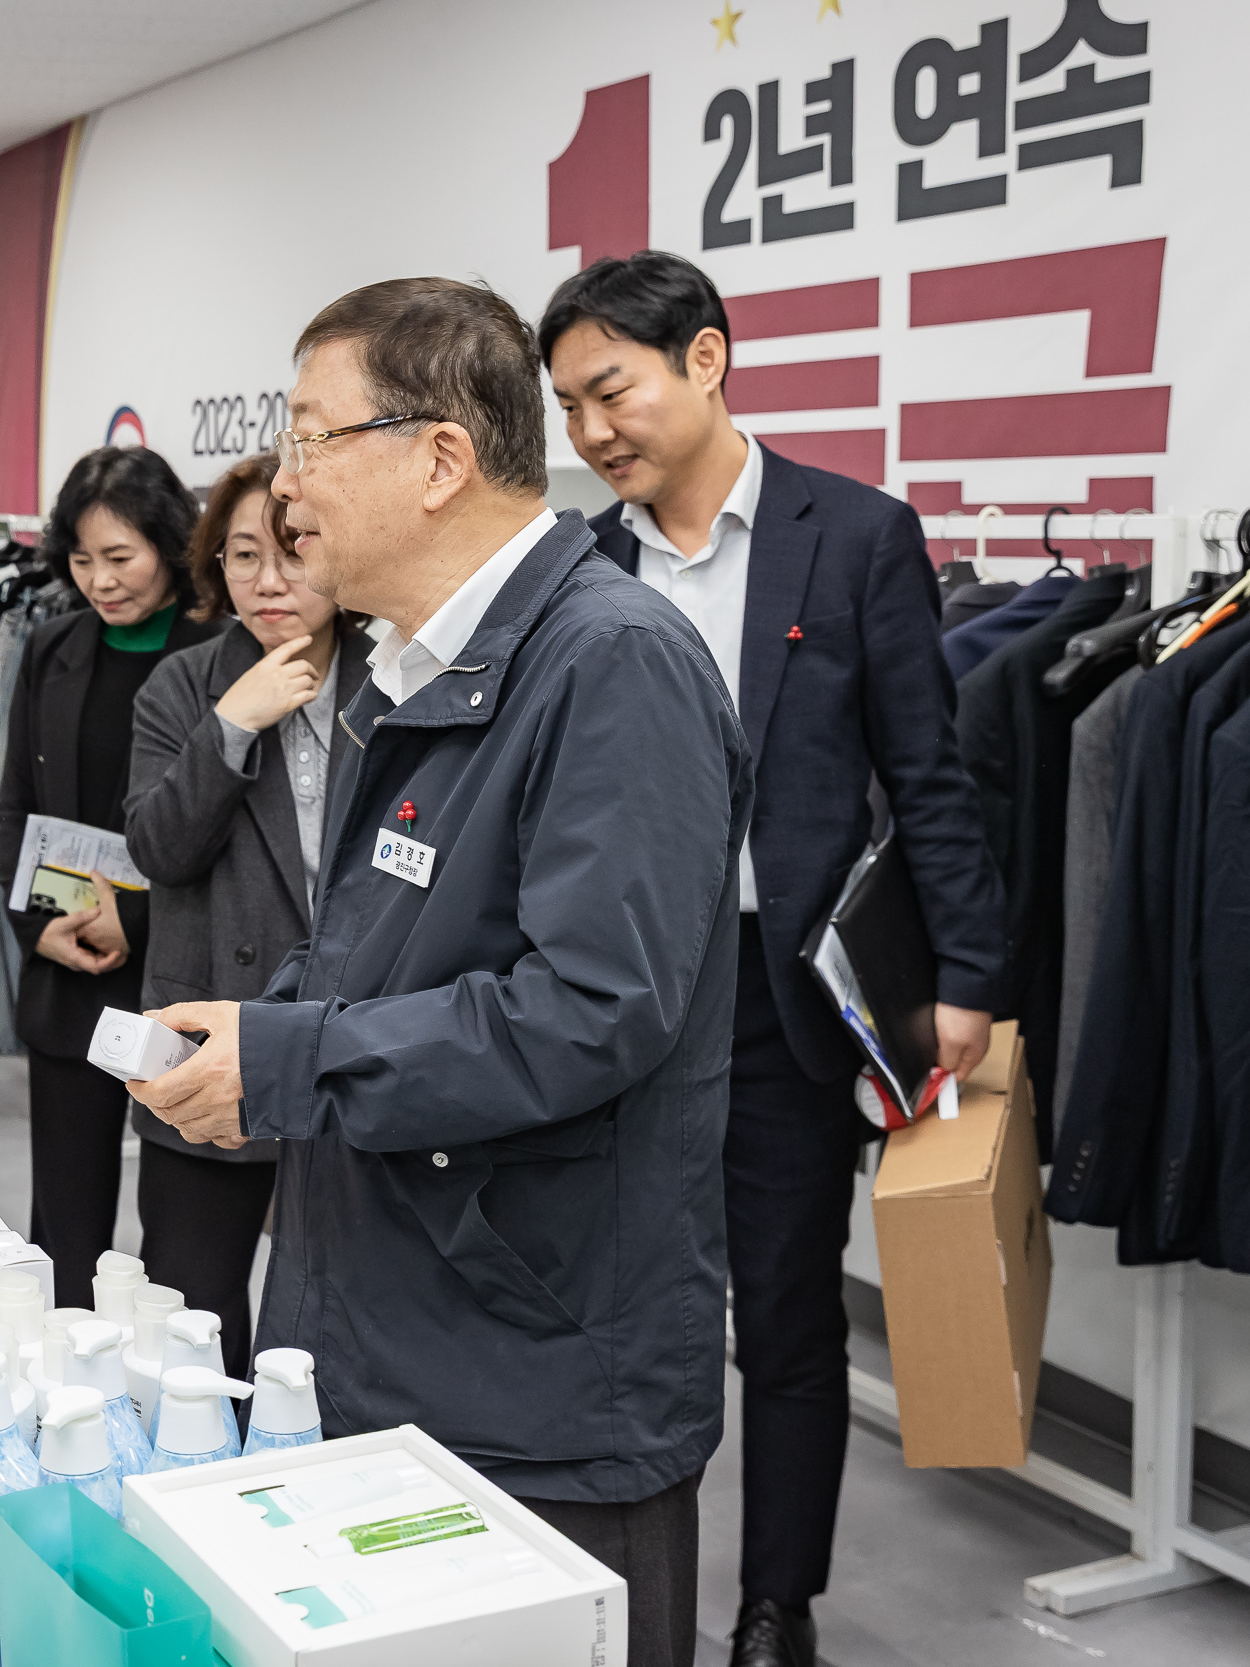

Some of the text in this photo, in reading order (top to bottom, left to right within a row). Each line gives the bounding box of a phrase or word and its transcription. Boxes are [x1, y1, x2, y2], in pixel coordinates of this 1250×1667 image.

[702, 0, 1153, 251] 2년 연속
[191, 391, 288, 455] 2023-20
